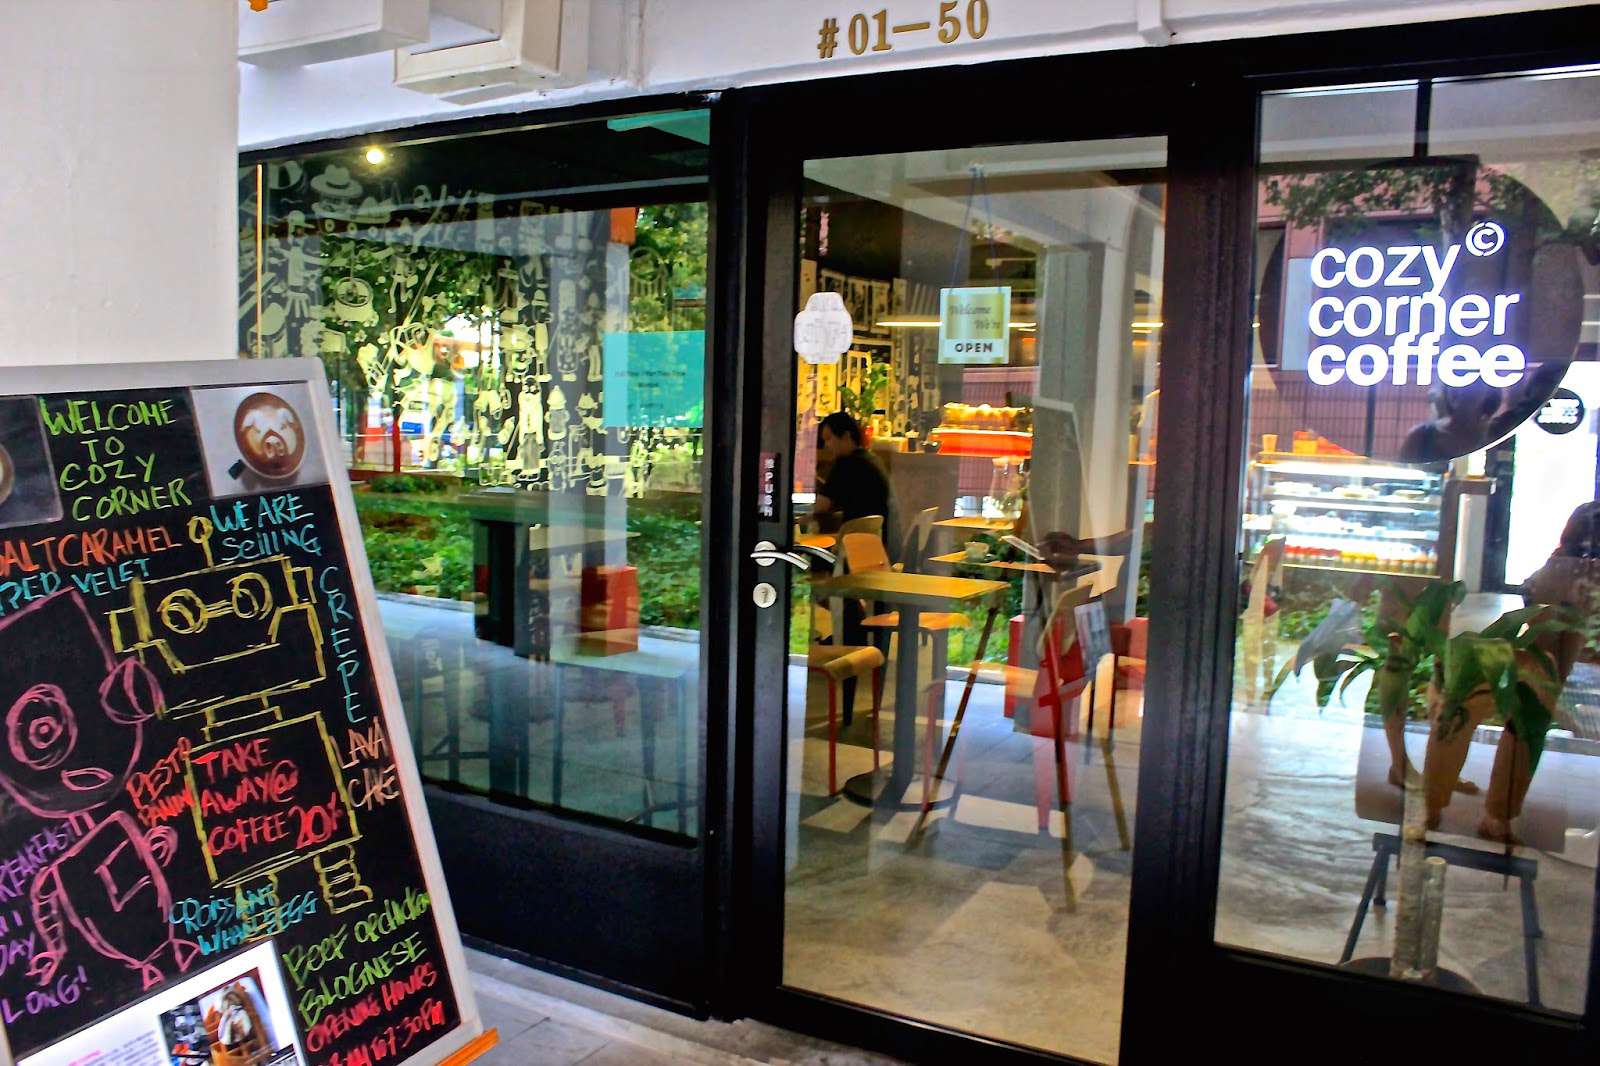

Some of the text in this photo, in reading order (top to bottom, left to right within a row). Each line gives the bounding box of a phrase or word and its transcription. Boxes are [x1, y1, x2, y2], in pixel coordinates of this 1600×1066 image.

[1310, 244, 1462, 298] cozy
[1308, 292, 1520, 338] corner
[954, 342, 993, 353] OPEN
[1307, 331, 1526, 388] coffee
[39, 395, 177, 436] WELCOME
[59, 453, 156, 492] COZY
[81, 436, 125, 463] TO
[72, 478, 193, 521] CORNER
[209, 493, 315, 532] WE ARE
[0, 526, 183, 577] ALT CARAMEL
[191, 737, 272, 784] TAKE
[347, 764, 400, 812] CAKE
[207, 811, 290, 857] COFFEE
